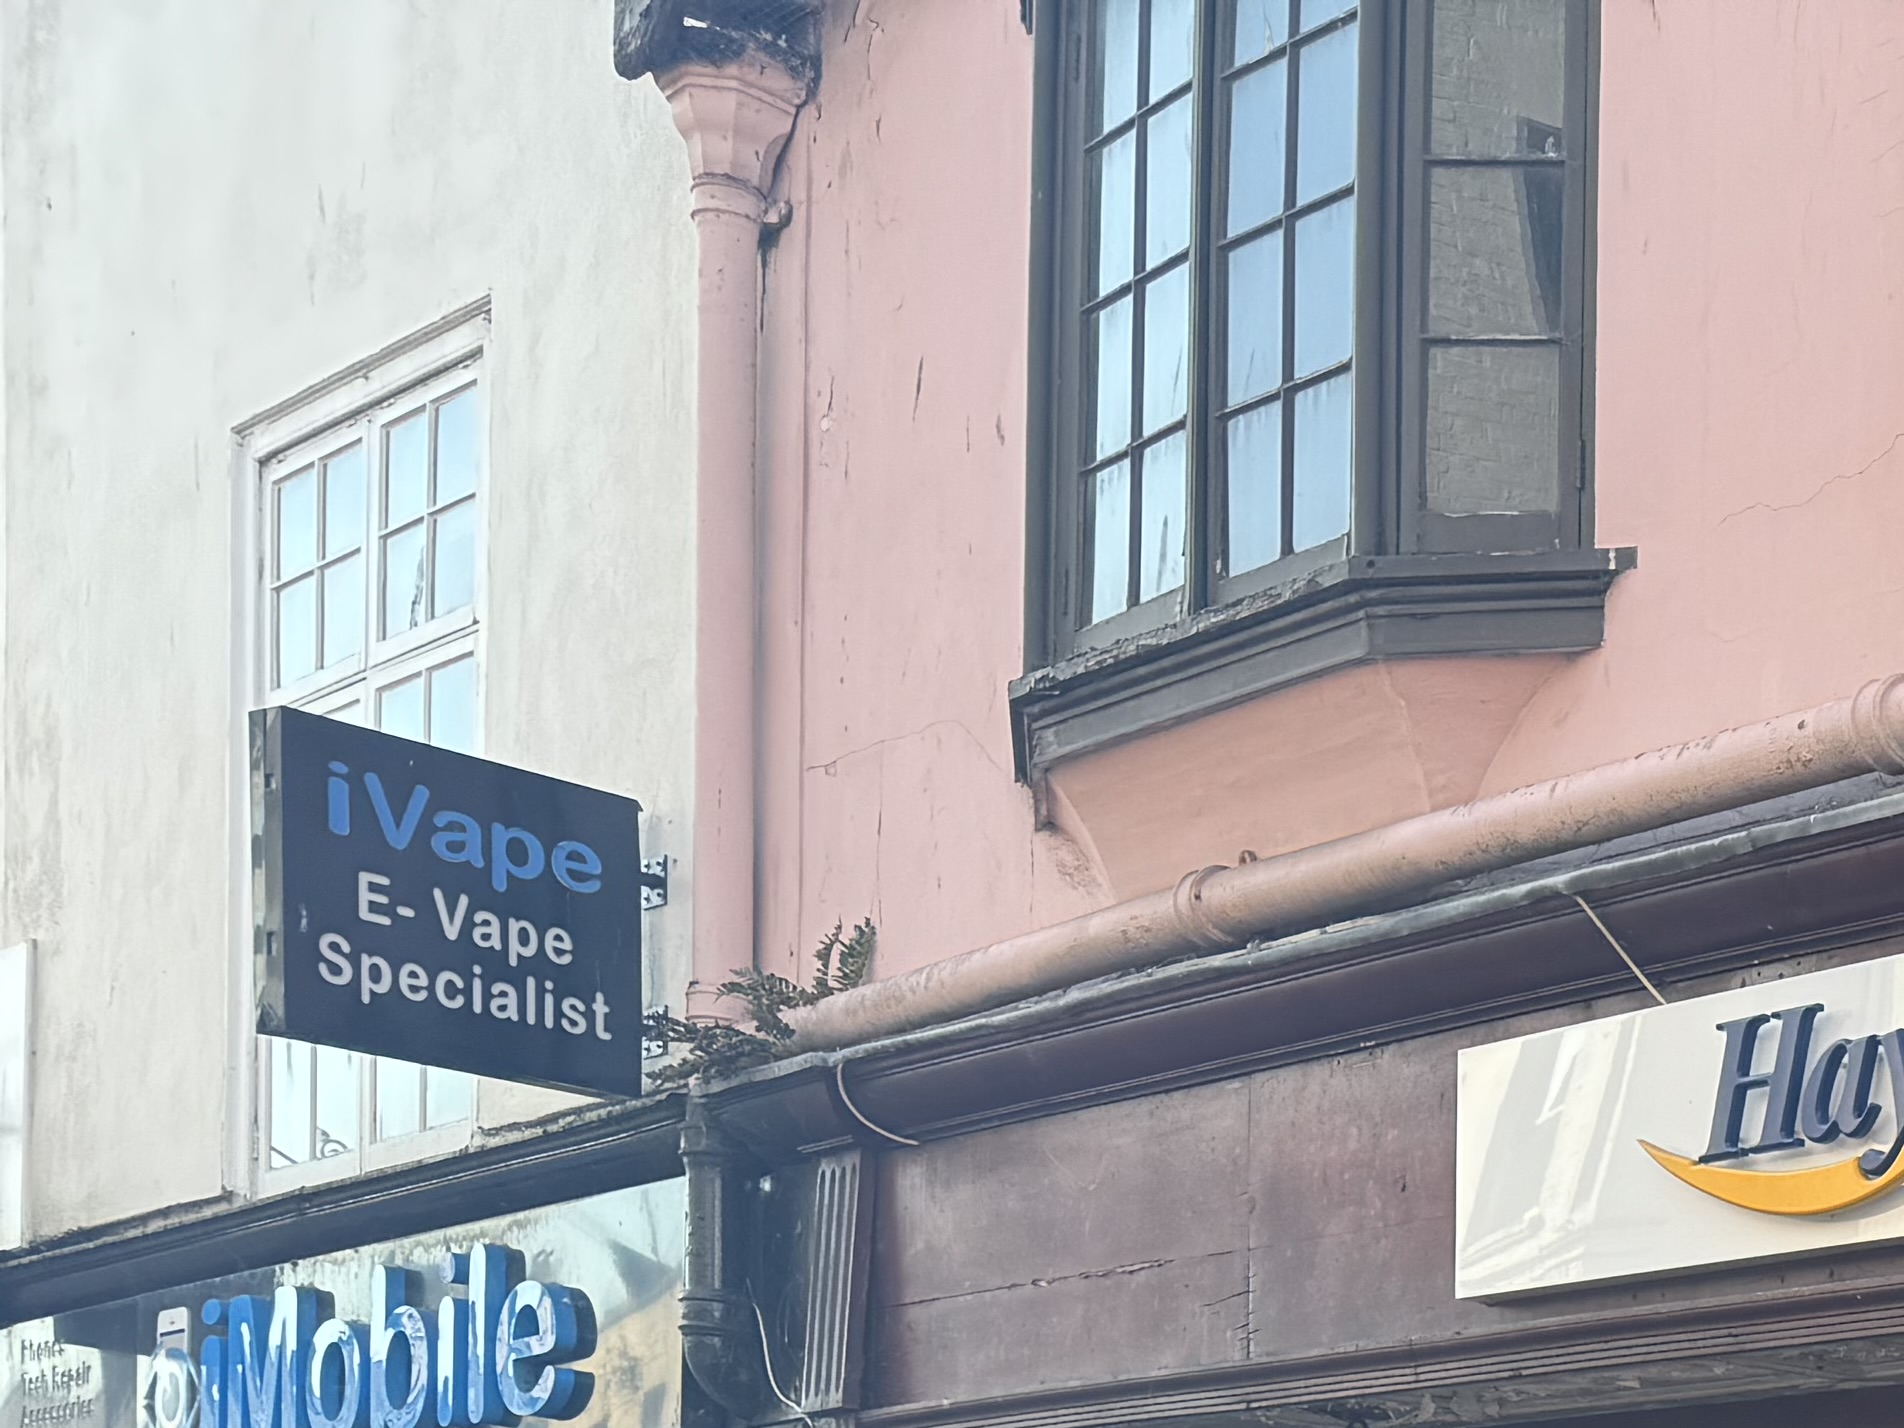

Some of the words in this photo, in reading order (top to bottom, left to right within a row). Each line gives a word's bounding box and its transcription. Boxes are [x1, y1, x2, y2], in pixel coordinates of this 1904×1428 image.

[327, 760, 603, 895] iVape
[434, 886, 574, 967] Vape
[317, 932, 612, 1041] Specialist
